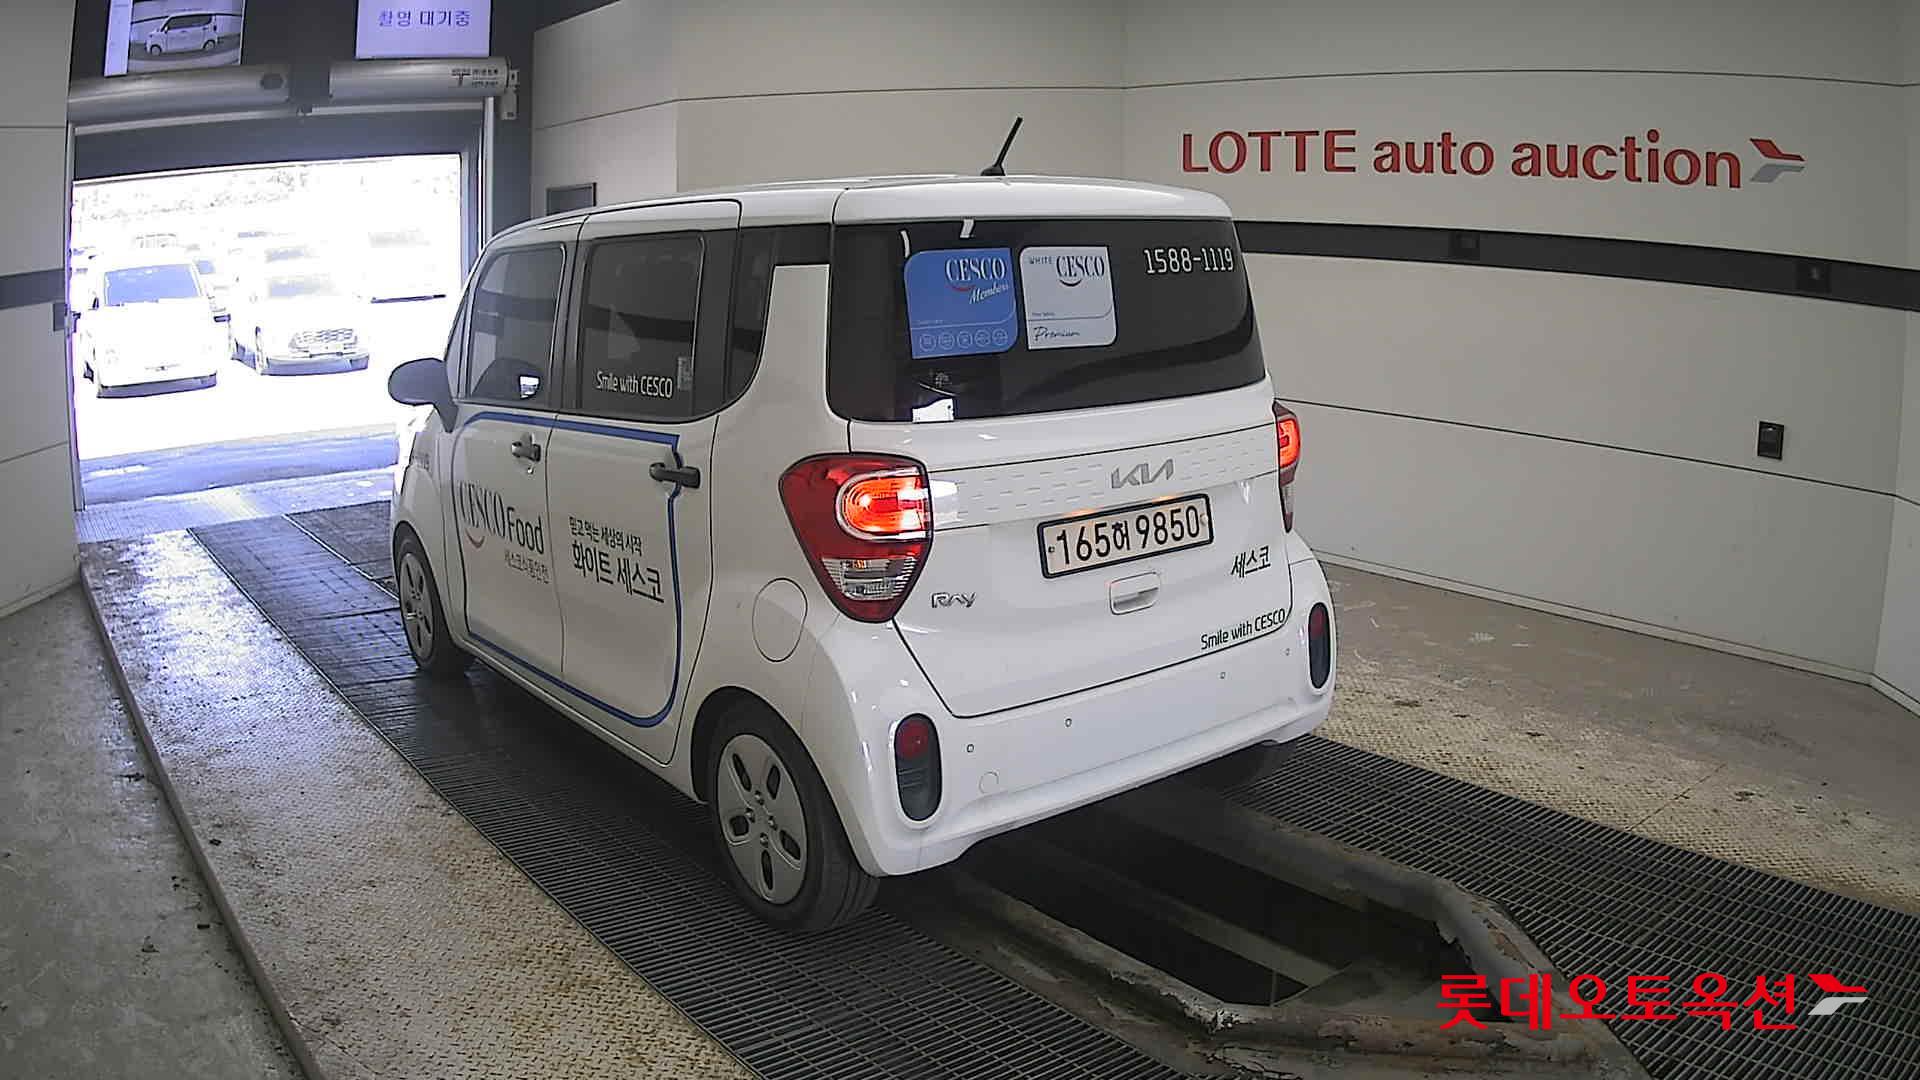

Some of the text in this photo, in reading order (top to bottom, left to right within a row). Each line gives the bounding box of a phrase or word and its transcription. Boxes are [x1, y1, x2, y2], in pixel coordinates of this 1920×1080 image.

[420, 10, 470, 27] 대기중
[1183, 129, 1742, 189] LOTTE auto auction
[945, 257, 1006, 281] CESCO
[1056, 255, 1105, 278] CESCO
[1144, 247, 1234, 274] 1588-1119
[1033, 325, 1081, 341] Premium
[596, 370, 673, 398] Smile with CESCO
[459, 481, 545, 555] CESCO Food
[572, 540, 665, 604] 화이트 세스코
[1231, 545, 1271, 578] 세스코
[1201, 608, 1286, 650] Smile with CESCO
